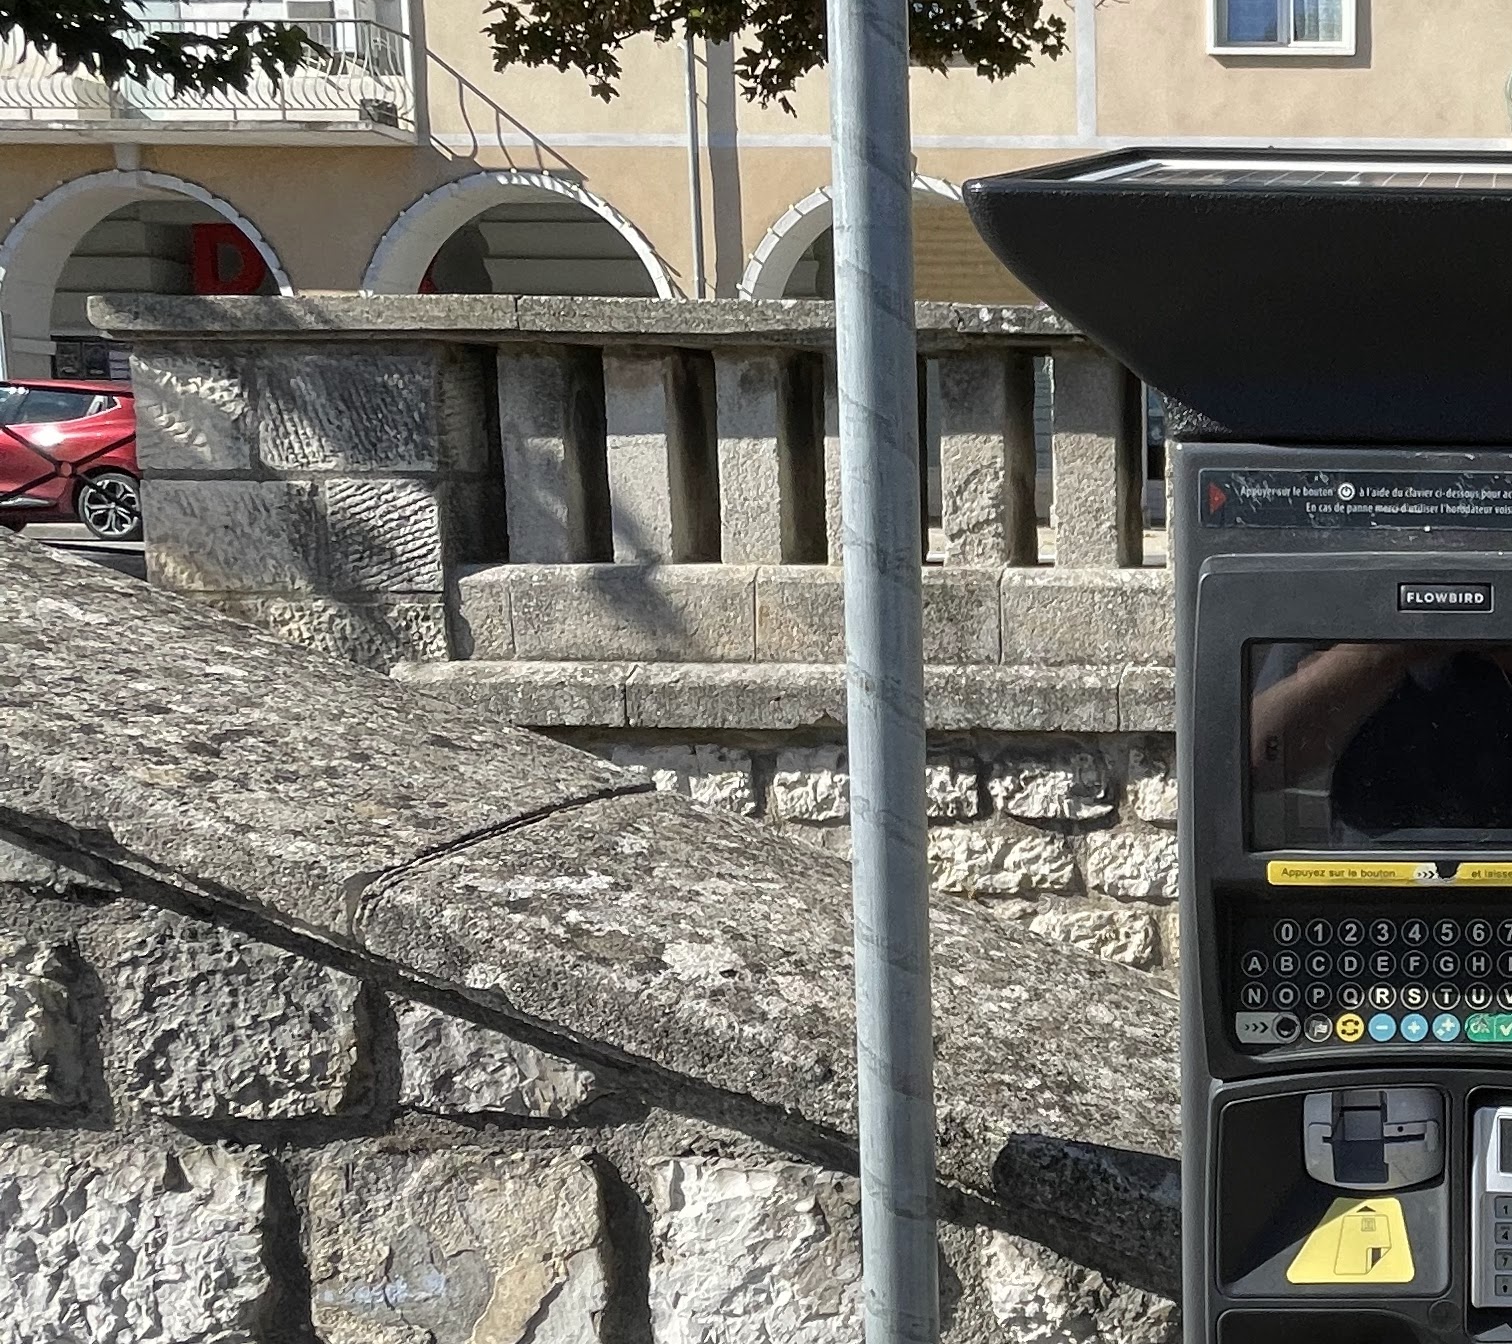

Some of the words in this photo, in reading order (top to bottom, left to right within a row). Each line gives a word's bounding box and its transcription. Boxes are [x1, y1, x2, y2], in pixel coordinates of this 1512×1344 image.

[1293, 486, 1300, 497] le
[1303, 486, 1334, 497] bouton
[1306, 501, 1316, 513] En
[1318, 503, 1332, 513] cas
[1334, 501, 1345, 513] de
[1346, 503, 1373, 515] panne
[1406, 592, 1484, 604] FLOWBIRD
[1281, 867, 1326, 878] Appuyez
[1329, 869, 1345, 877] sur
[1348, 868, 1357, 877] le
[1361, 868, 1396, 878] bouton
[1471, 869, 1481, 878] et
[1282, 924, 1293, 942] 0
[1314, 923, 1322, 942] 1
[1345, 924, 1357, 942] 2
[1377, 924, 1388, 942] 3
[1409, 924, 1421, 942] 4
[1441, 924, 1453, 942] 5
[1473, 924, 1484, 942] 6
[1248, 957, 1262, 972] A
[1281, 957, 1293, 972] B
[1313, 957, 1325, 972] C
[1345, 957, 1357, 972] D
[1378, 957, 1389, 972] E
[1410, 957, 1420, 972] F
[1440, 957, 1453, 972] G
[1473, 957, 1484, 972] H
[1249, 989, 1260, 1004] N
[1279, 988, 1293, 1004] O
[1313, 989, 1324, 1004] P
[1343, 989, 1358, 1004] Q
[1376, 988, 1389, 1004] R
[1408, 989, 1420, 1005] S
[1441, 989, 1452, 1005] T
[1472, 989, 1484, 1005] U
